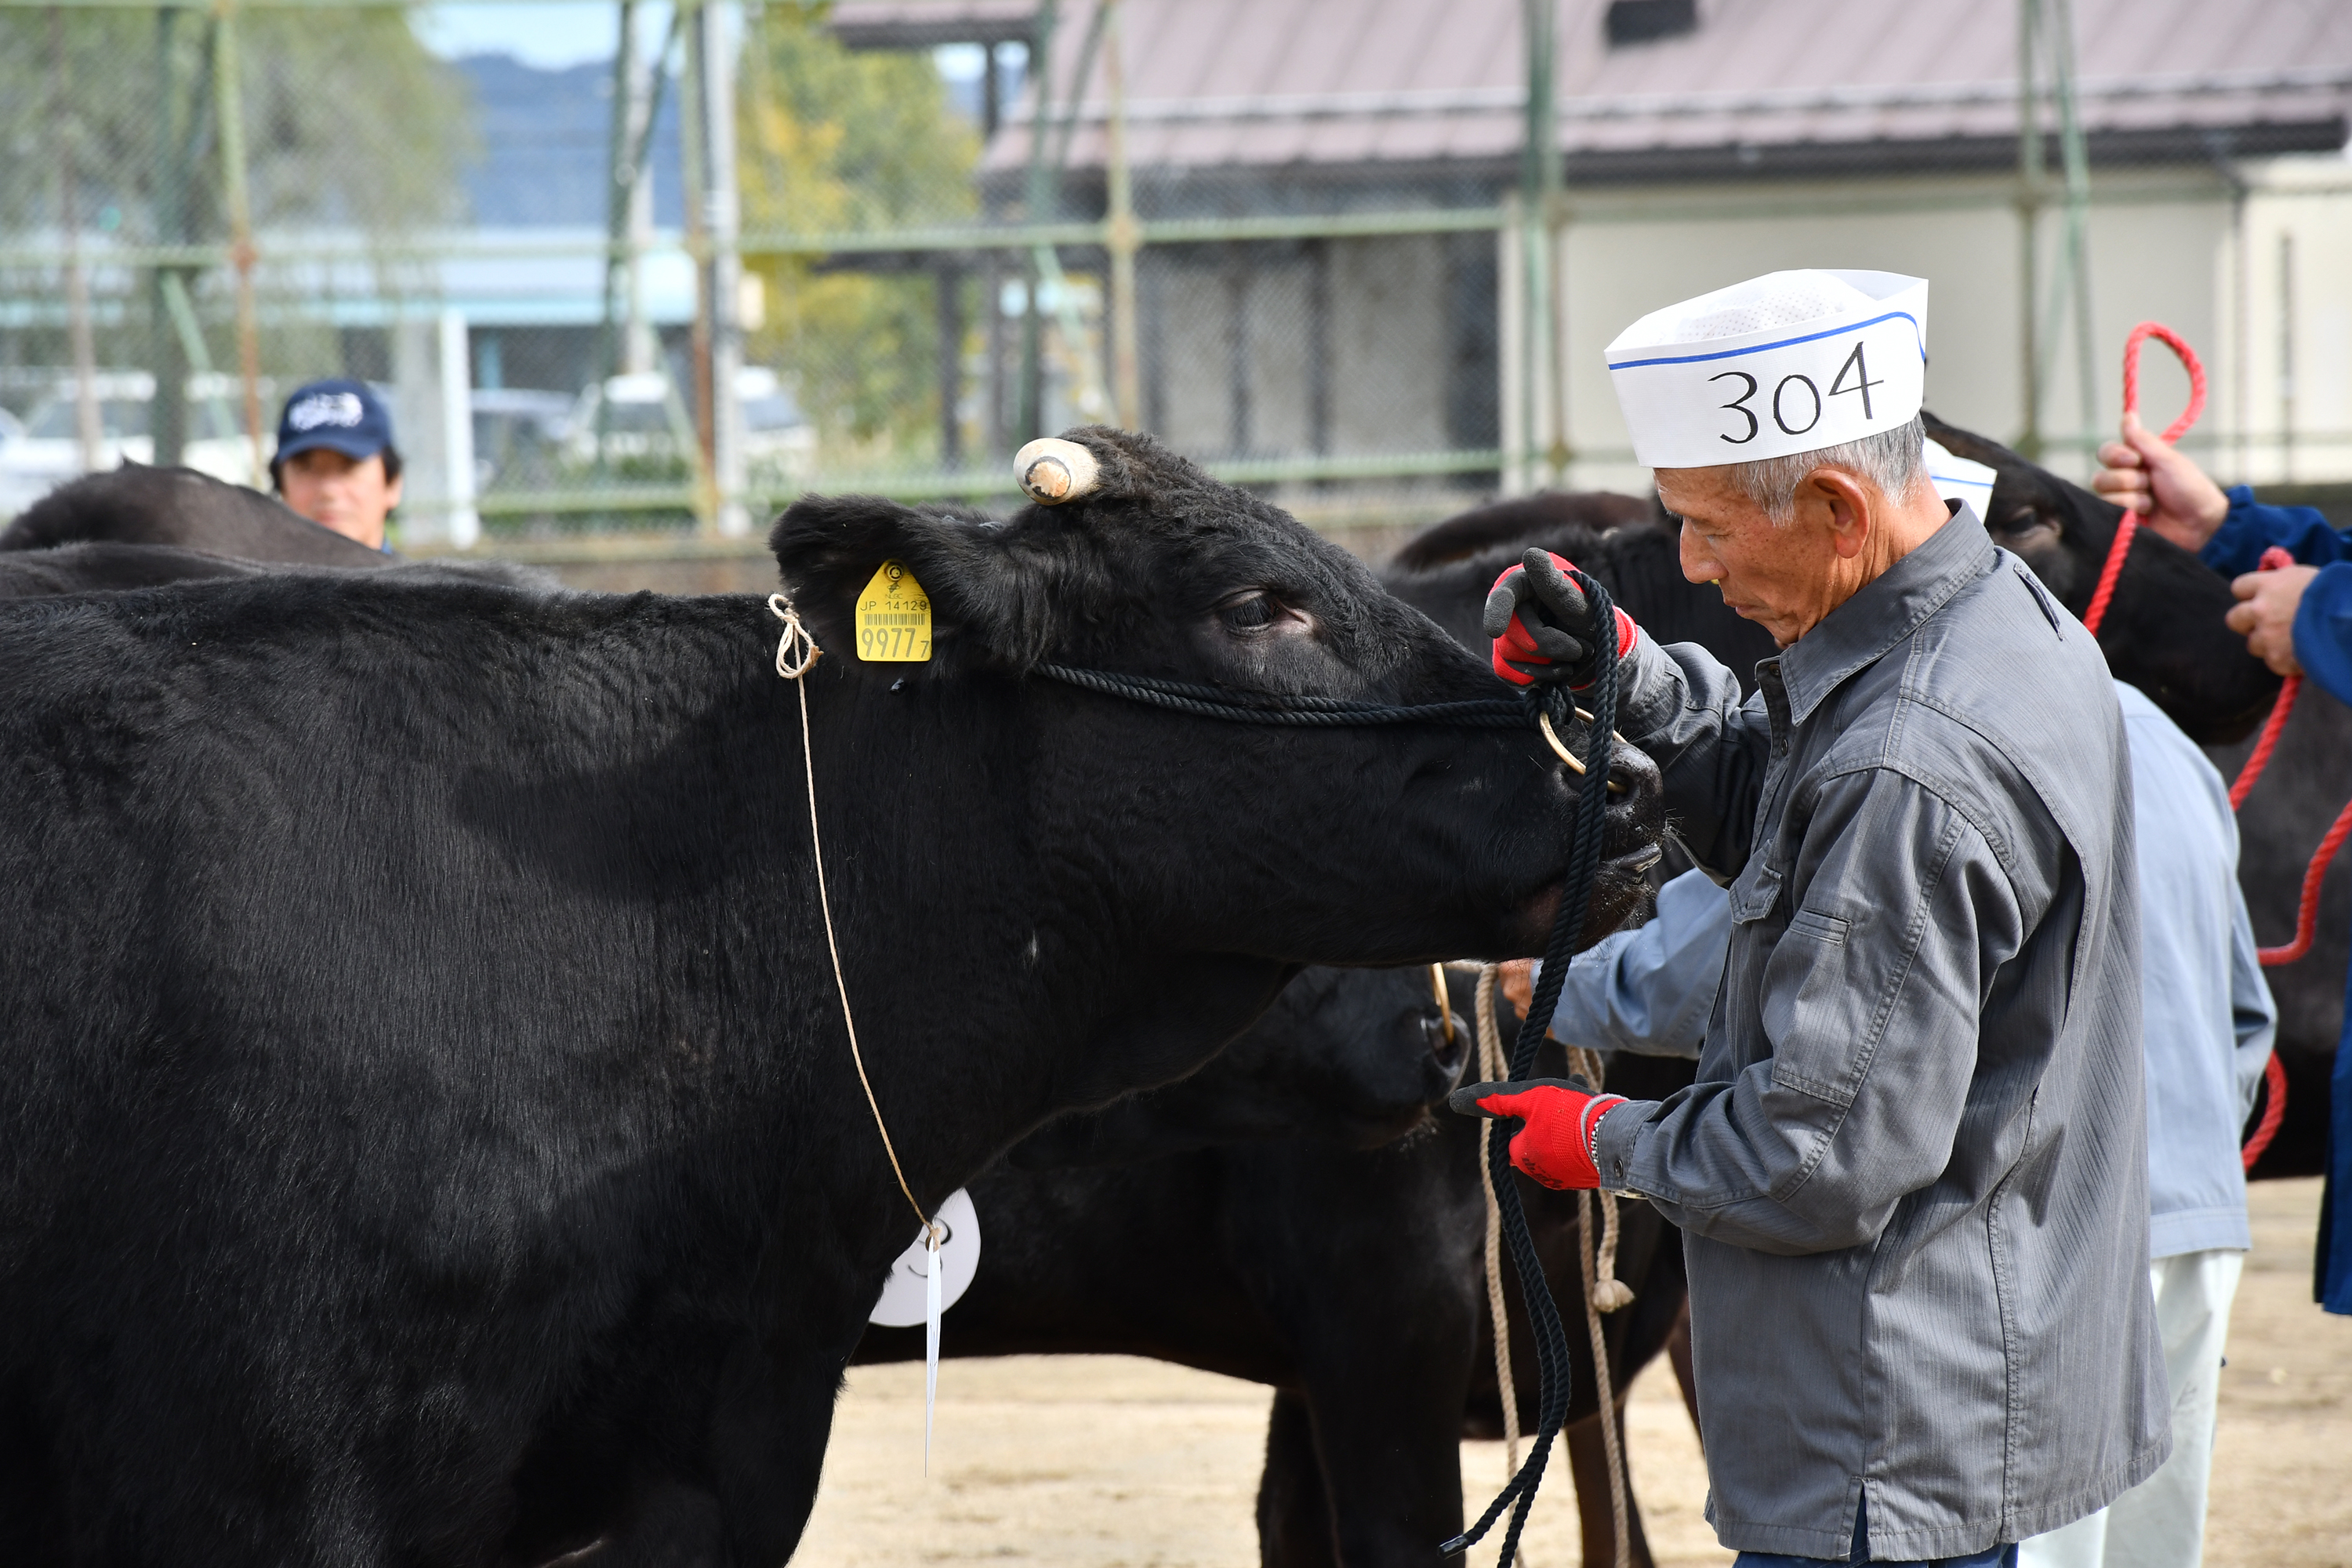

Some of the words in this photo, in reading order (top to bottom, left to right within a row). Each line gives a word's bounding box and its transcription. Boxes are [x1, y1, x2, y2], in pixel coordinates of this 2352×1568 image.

[1707, 340, 1884, 445] 304
[860, 601, 877, 612] JP
[885, 601, 927, 611] 14129
[861, 627, 916, 658] 9977
